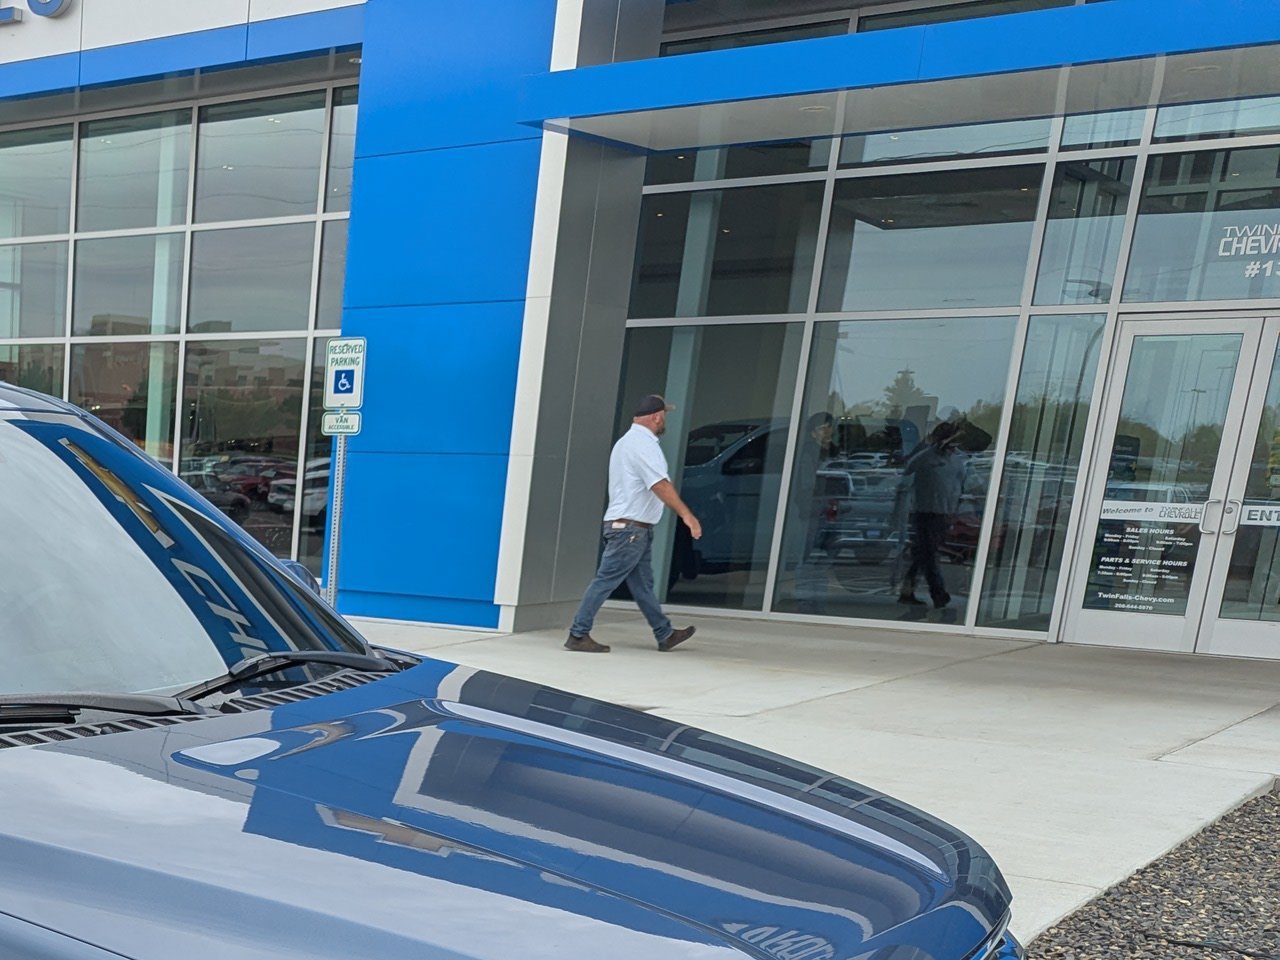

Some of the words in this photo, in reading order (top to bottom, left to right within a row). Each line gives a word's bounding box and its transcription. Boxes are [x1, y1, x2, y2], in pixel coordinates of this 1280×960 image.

[1223, 223, 1280, 238] TWIN
[1244, 260, 1280, 278] #1
[329, 344, 363, 355] RESERVED
[330, 356, 360, 367] PARKING
[335, 416, 349, 424] VAN
[1102, 507, 1142, 515] Welcome
[1131, 558, 1161, 566] SERVICE
[1098, 592, 1175, 603] TwinFalls-Chevy.com
